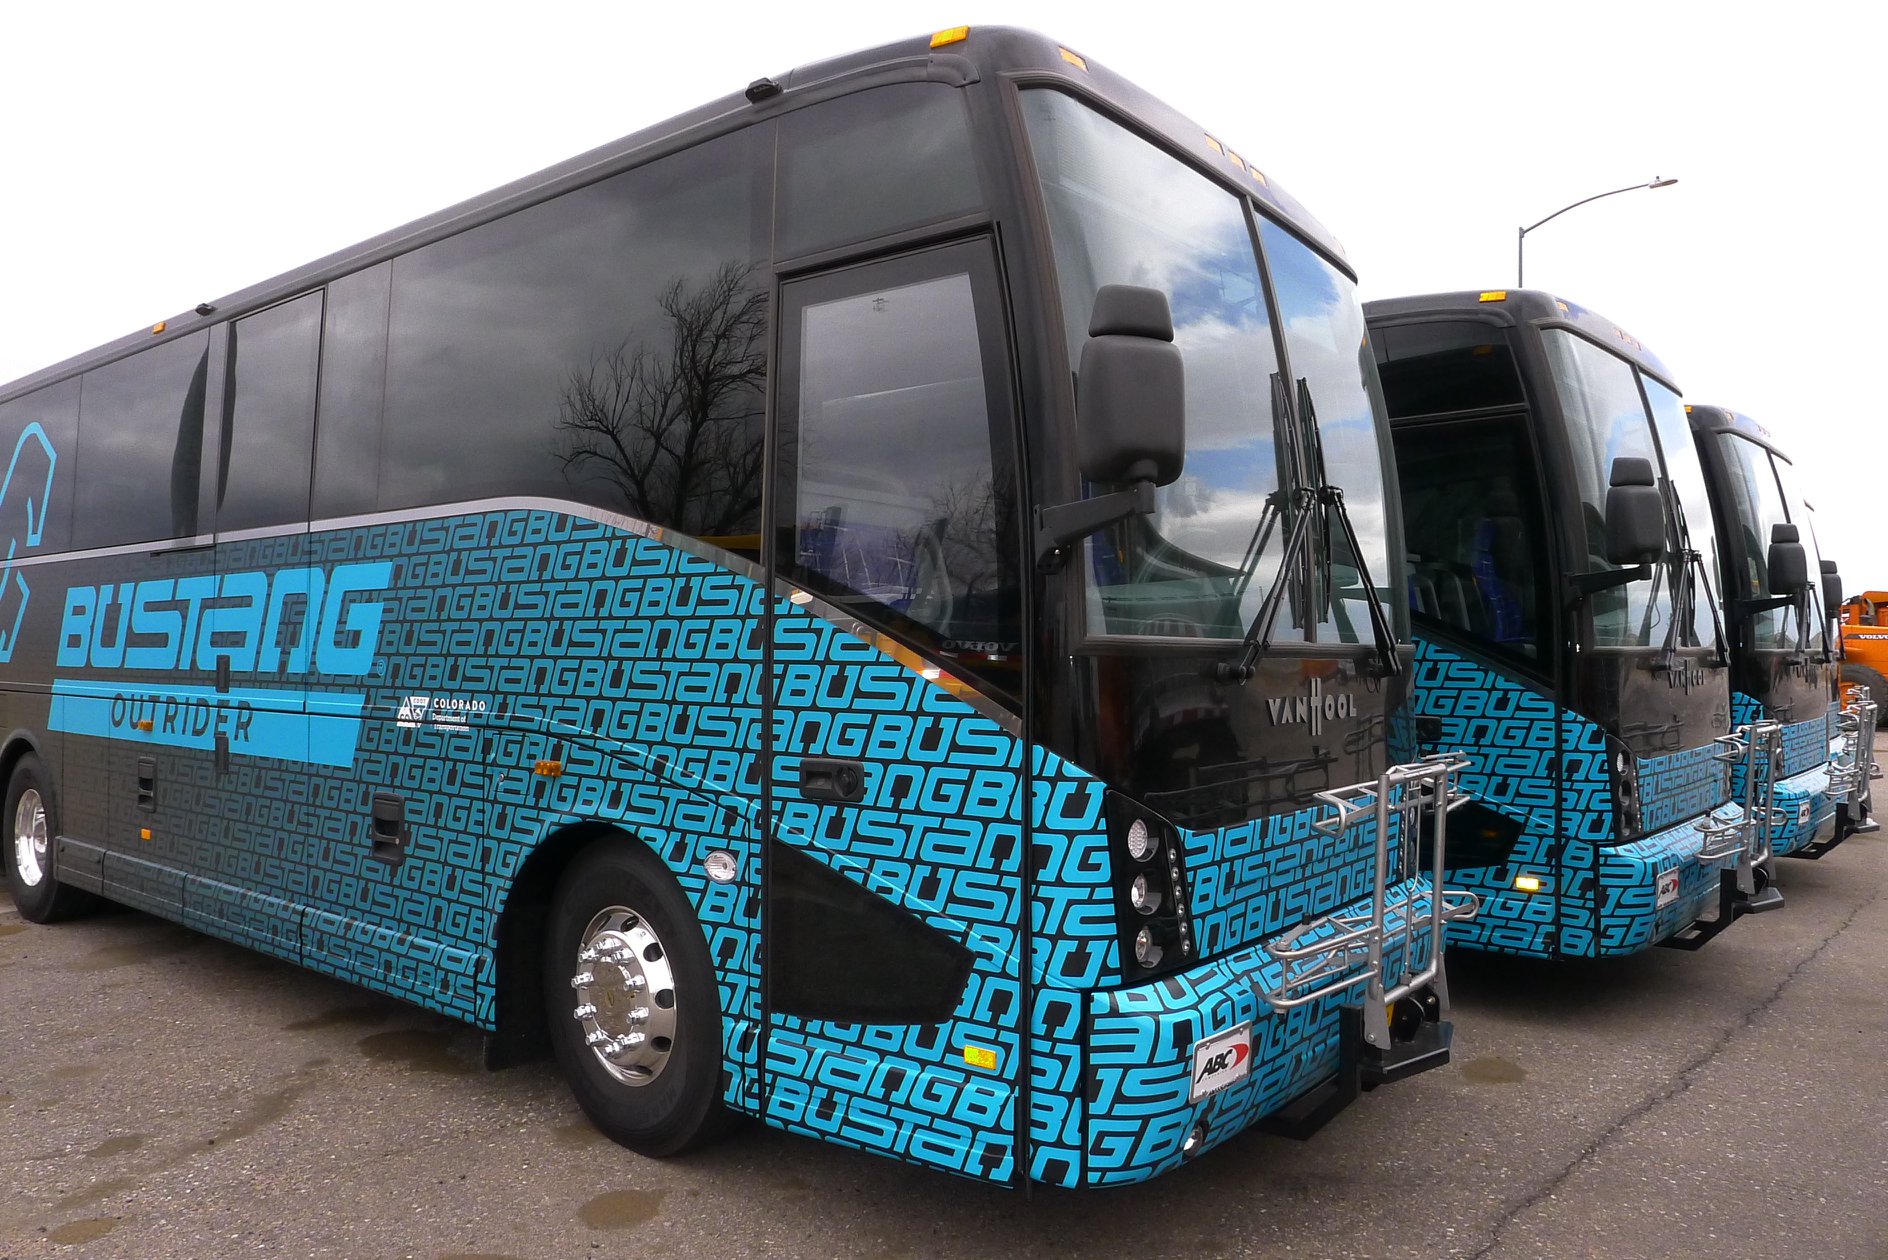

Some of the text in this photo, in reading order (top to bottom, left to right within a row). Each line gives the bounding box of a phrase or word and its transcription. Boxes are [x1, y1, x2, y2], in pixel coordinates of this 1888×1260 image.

[56, 562, 393, 675] BUSTANG
[111, 692, 253, 742] OUTRIDER
[432, 713, 460, 723] Department
[434, 698, 486, 711] COLORADO
[1196, 1049, 1233, 1084] ABC
